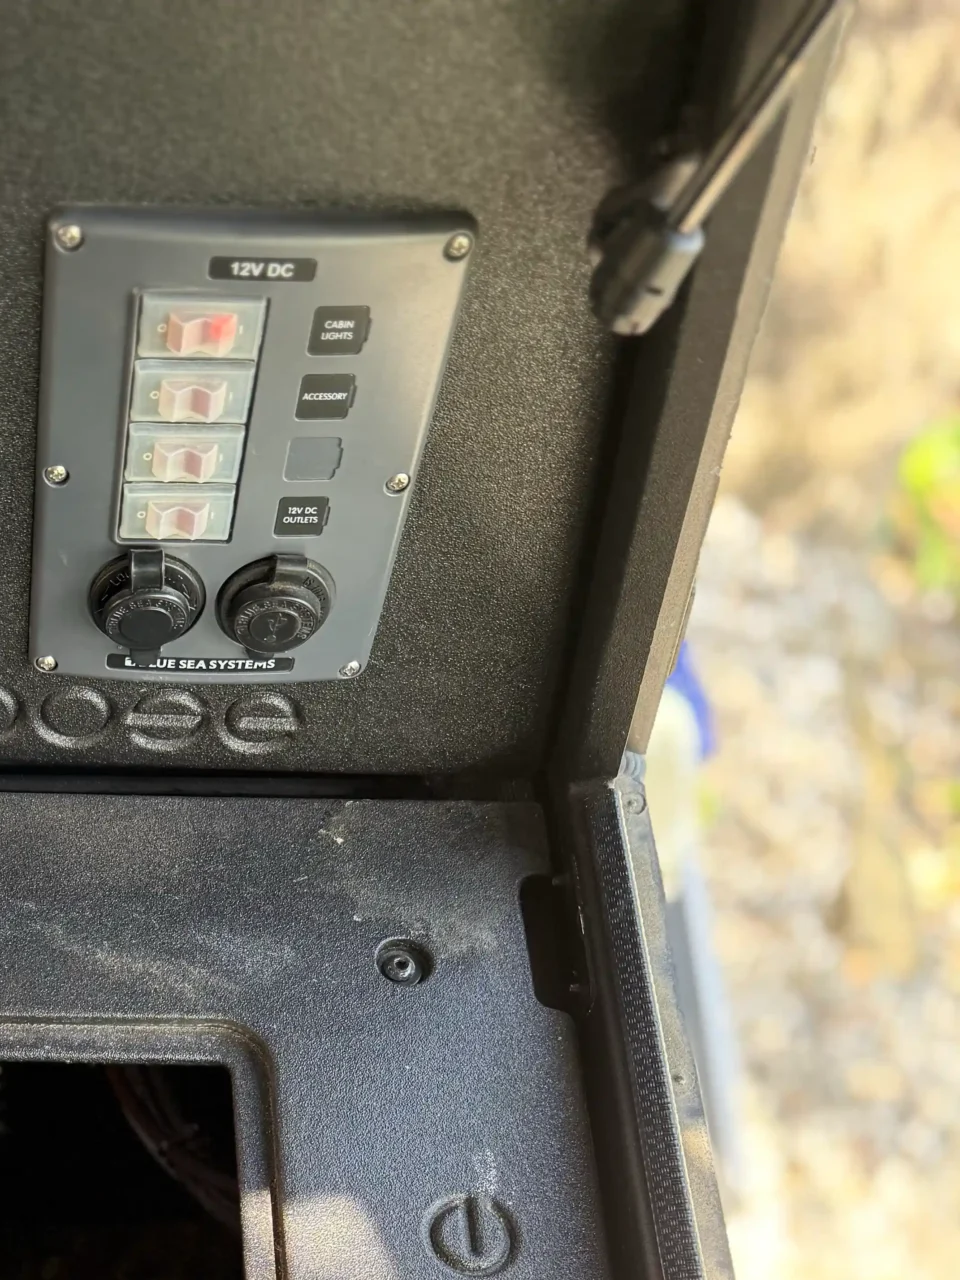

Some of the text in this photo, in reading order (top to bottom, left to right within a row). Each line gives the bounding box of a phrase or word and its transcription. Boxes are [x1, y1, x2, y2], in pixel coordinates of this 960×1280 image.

[230, 261, 294, 278] 12V DC
[324, 320, 355, 329] CABIN
[320, 331, 354, 340] LIGHTS
[302, 392, 348, 401] ACCESSORY
[179, 659, 207, 670] SEA
[209, 659, 276, 670] SYSTEMS
